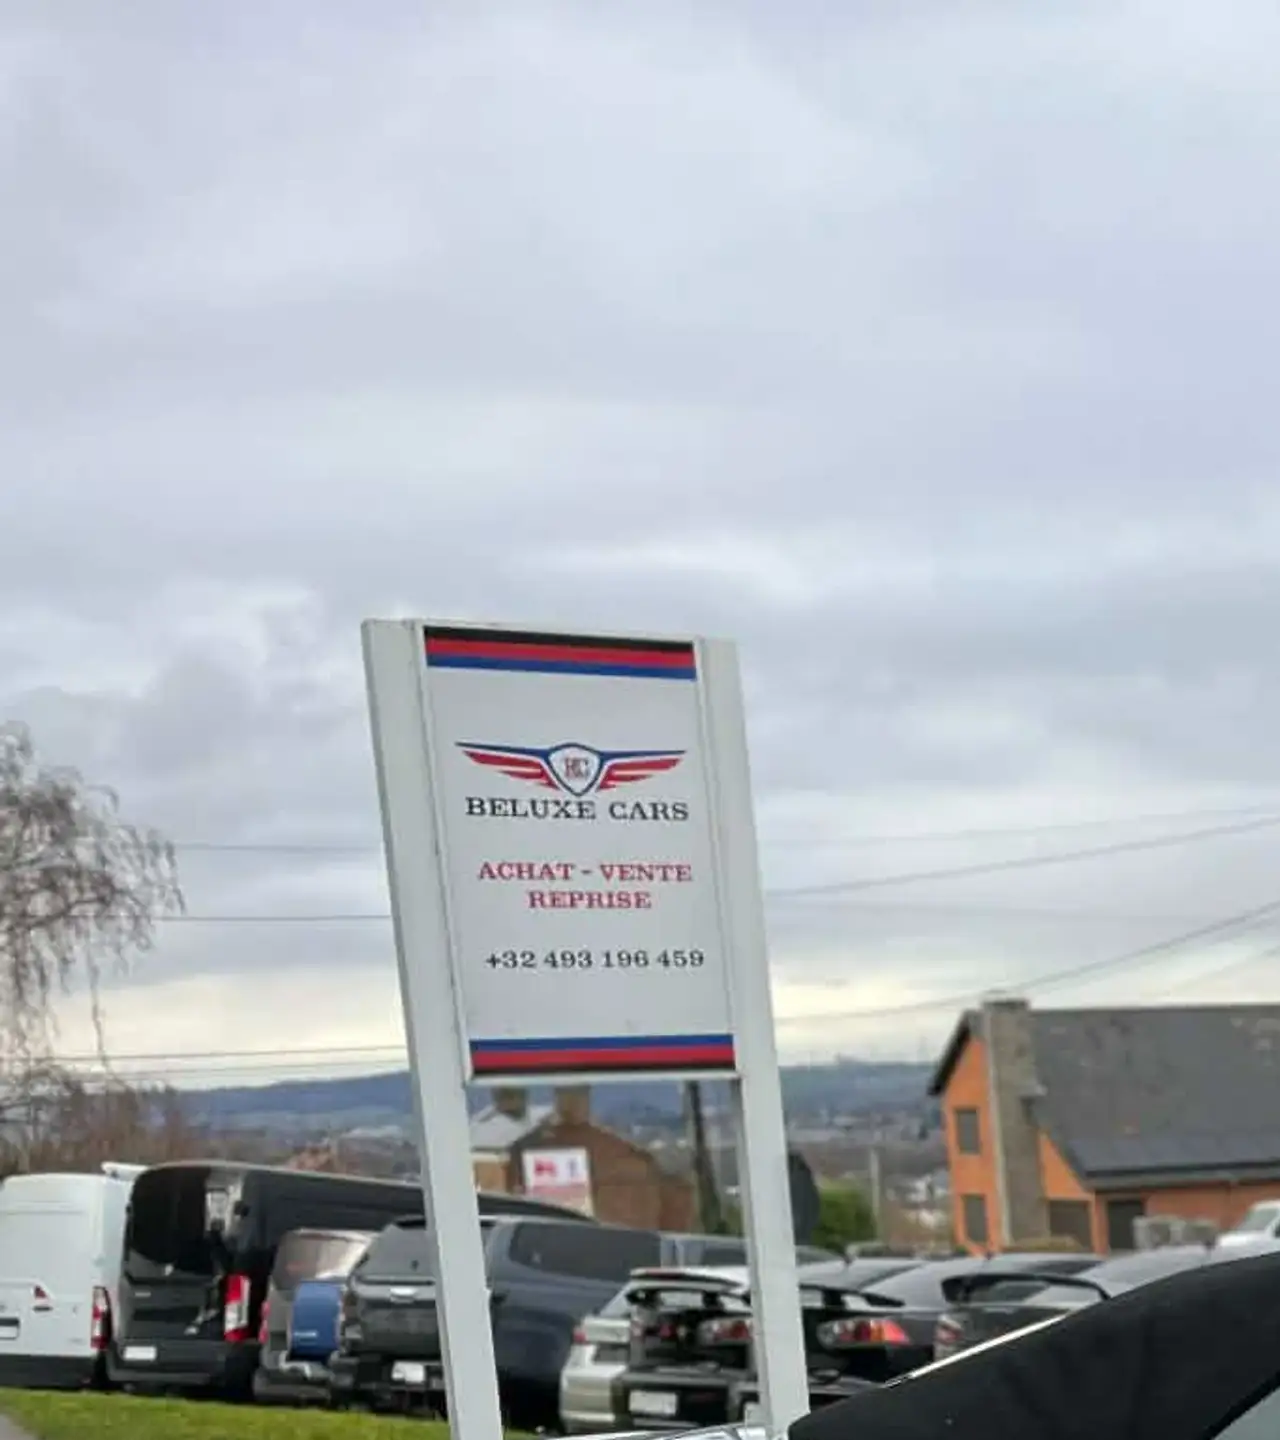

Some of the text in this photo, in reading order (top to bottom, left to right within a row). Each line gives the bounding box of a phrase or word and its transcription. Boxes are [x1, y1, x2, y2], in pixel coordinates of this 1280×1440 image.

[465, 797, 689, 821] BELUXE CARS
[477, 862, 575, 880] ACHAT
[599, 864, 693, 881] VENTE
[527, 890, 652, 909] REPRISE
[485, 949, 705, 969] +32 493 196 459
